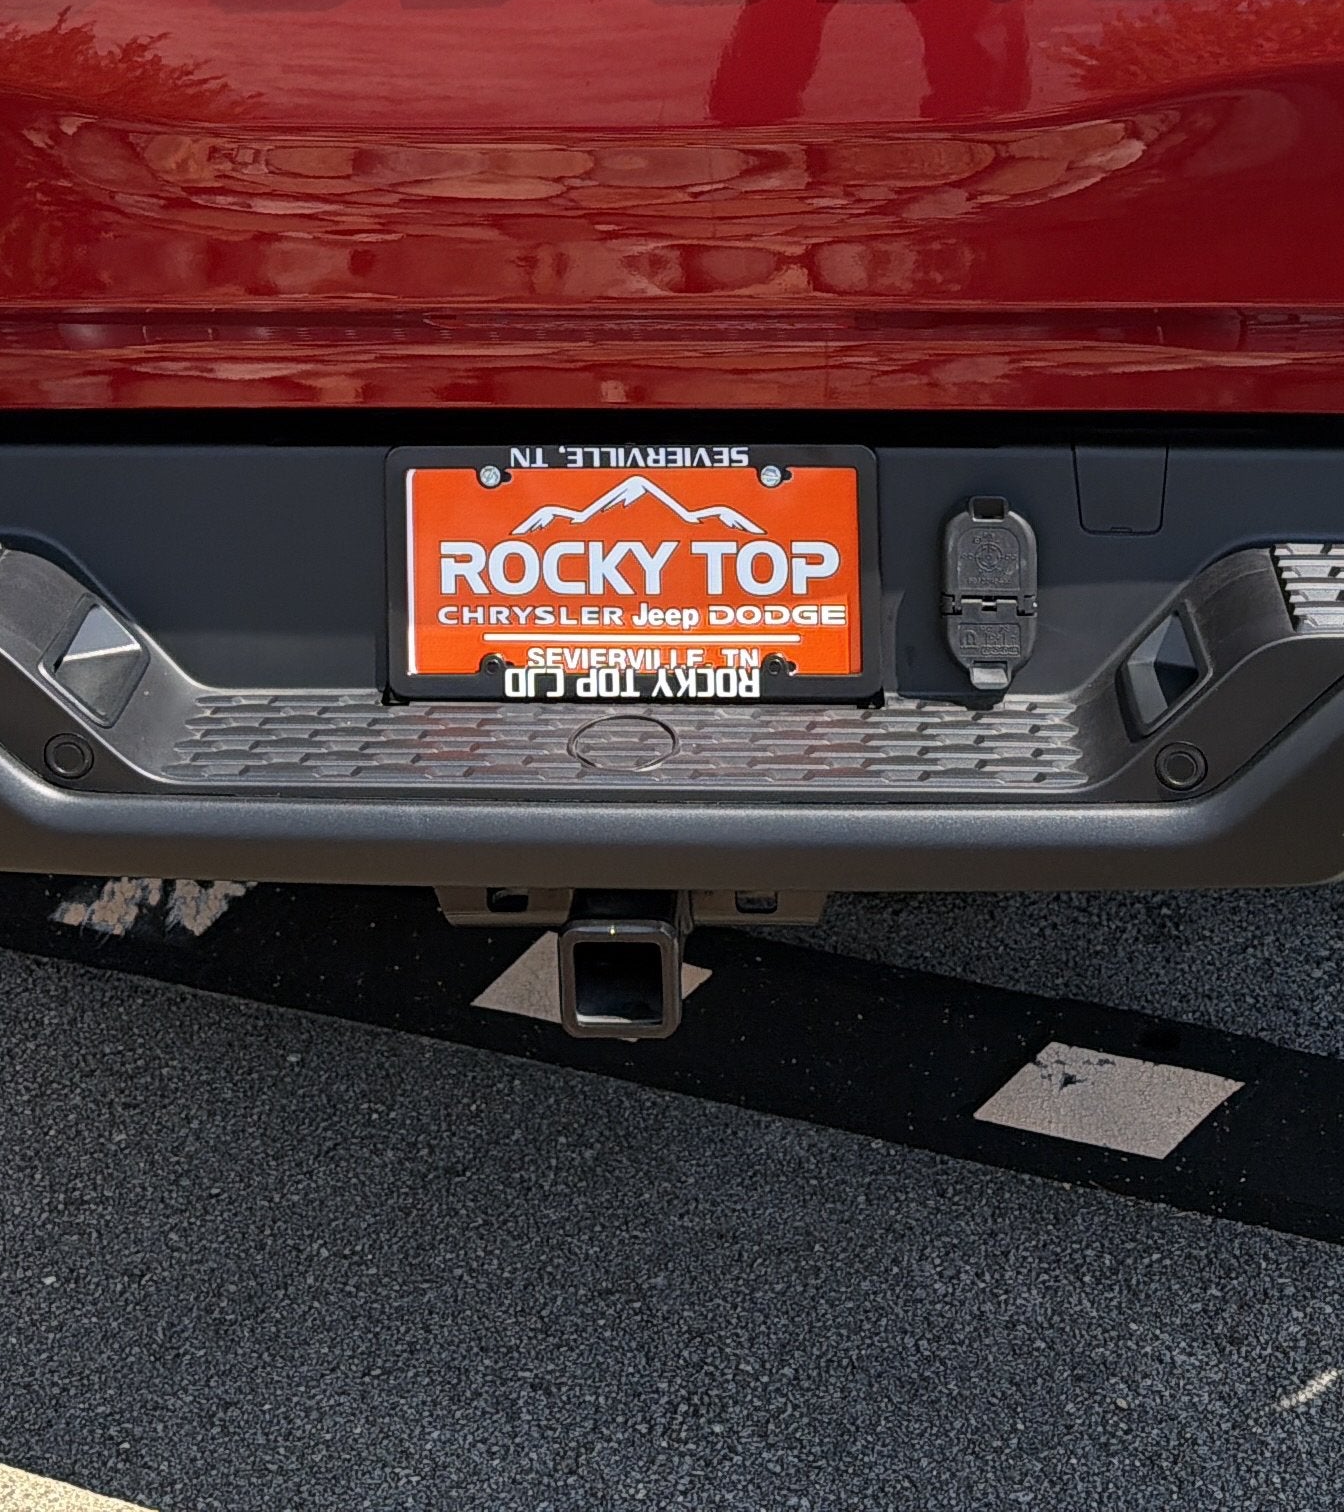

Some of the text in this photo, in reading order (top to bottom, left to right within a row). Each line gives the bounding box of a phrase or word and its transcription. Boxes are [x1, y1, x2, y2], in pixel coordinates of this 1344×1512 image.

[510, 446, 750, 468] SEVIERVILLE, TN
[439, 540, 840, 596] ROCKY TOP
[437, 602, 846, 631] CHRYSLER Jeep DODGE
[722, 648, 759, 669] TN
[504, 668, 761, 698] ROCKY TOP CJD
